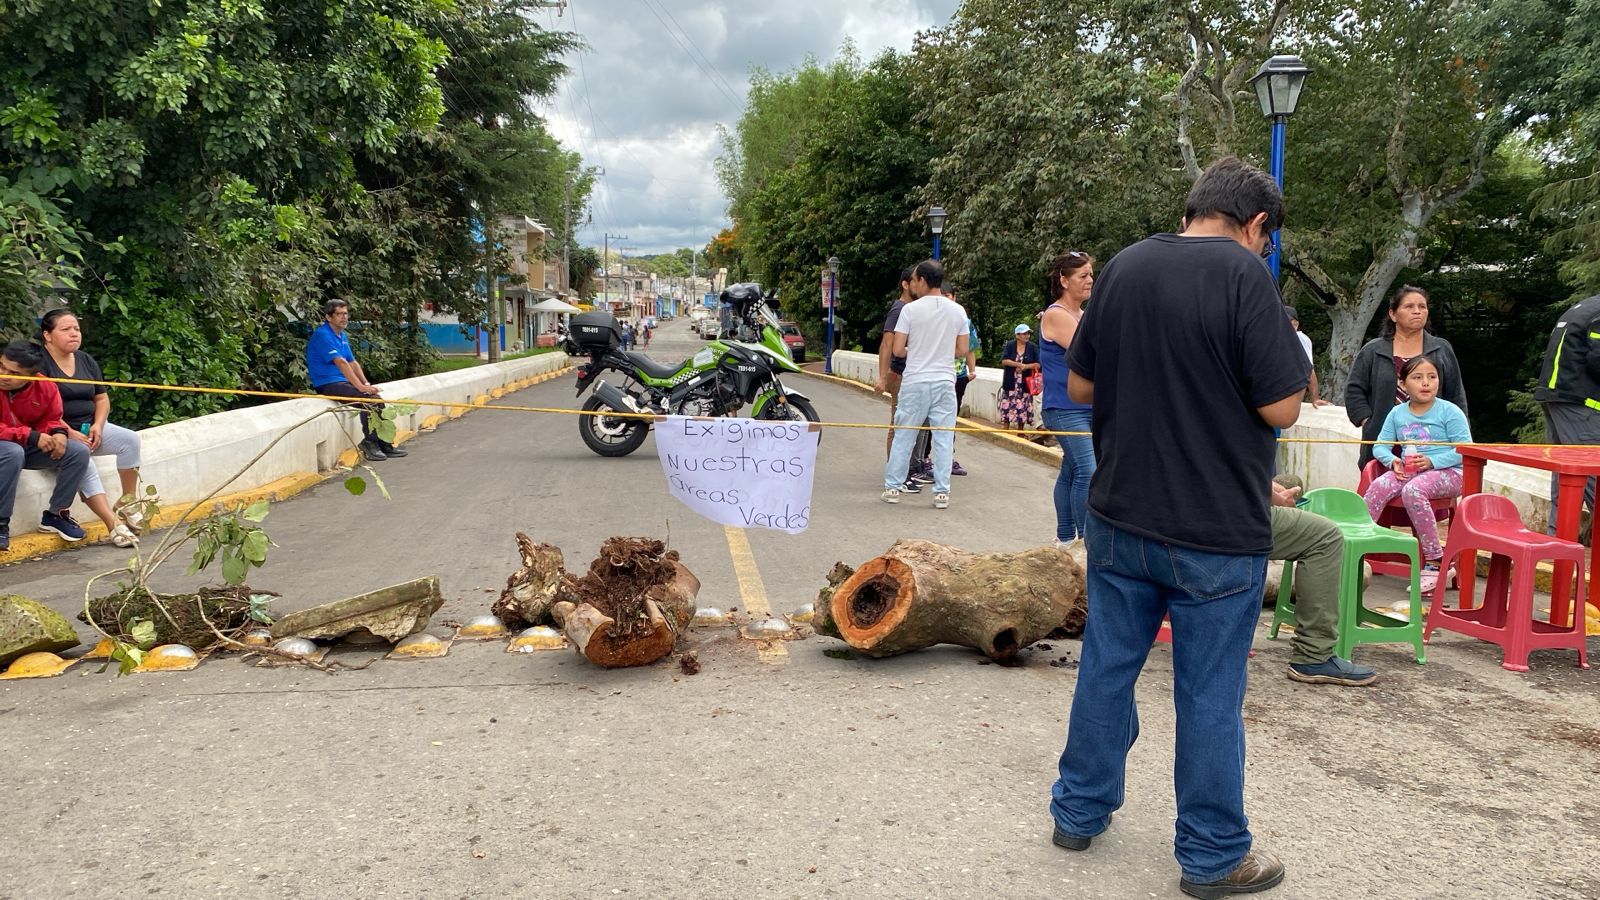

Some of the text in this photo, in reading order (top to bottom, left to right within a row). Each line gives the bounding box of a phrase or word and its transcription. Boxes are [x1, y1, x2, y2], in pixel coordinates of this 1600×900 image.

[685, 419, 801, 443] Exigimos
[668, 447, 804, 477] Nuestras
[739, 504, 810, 528] Verdes
